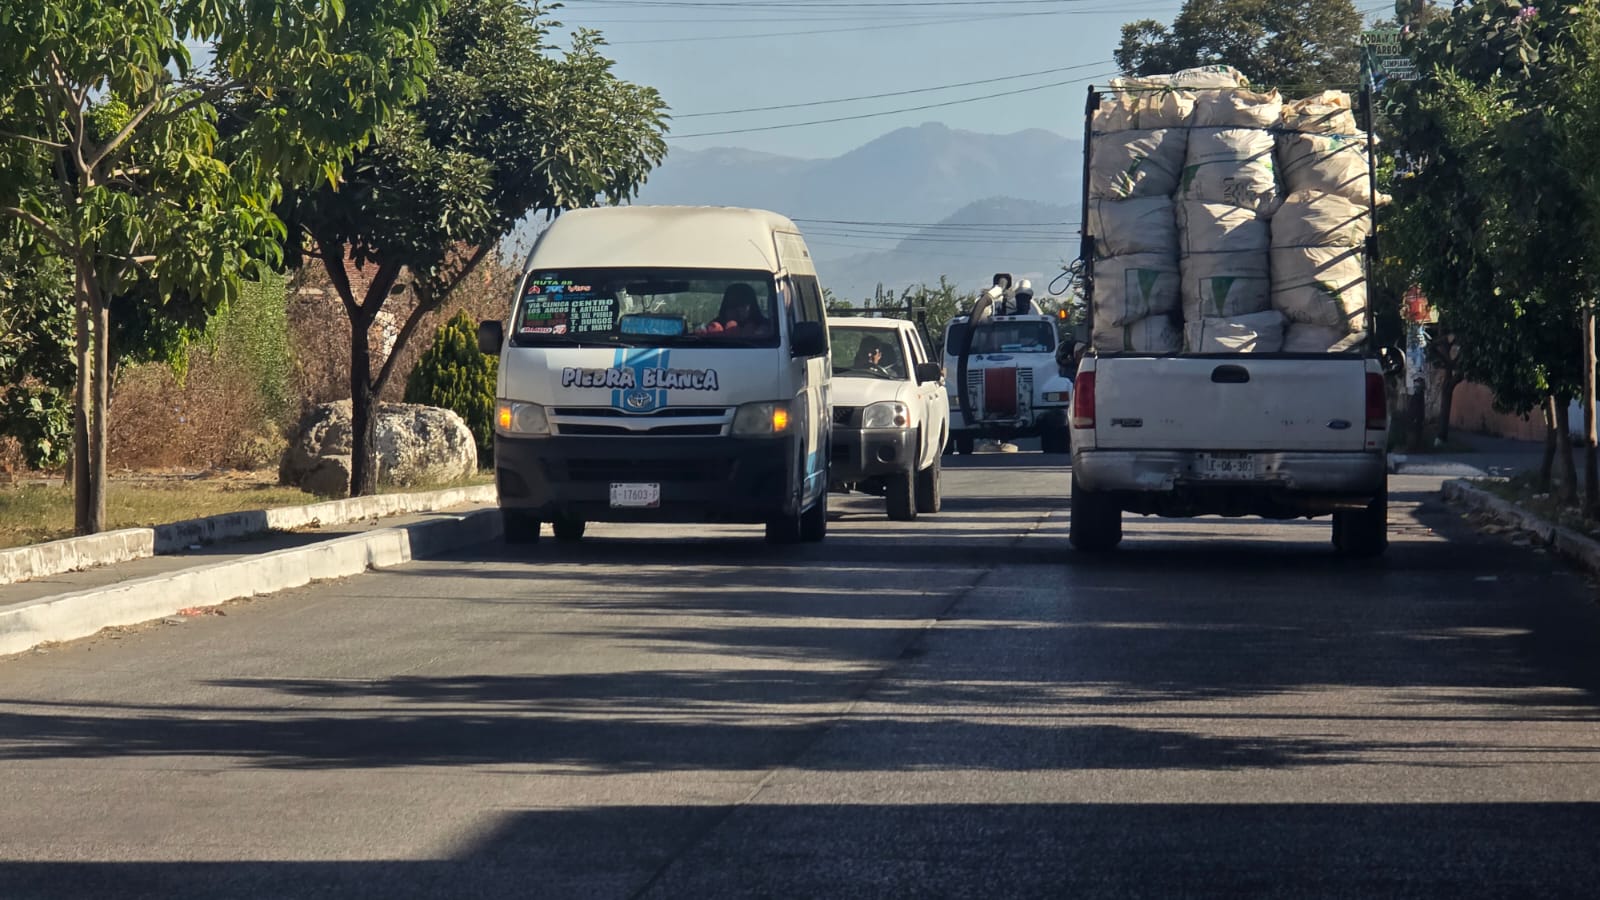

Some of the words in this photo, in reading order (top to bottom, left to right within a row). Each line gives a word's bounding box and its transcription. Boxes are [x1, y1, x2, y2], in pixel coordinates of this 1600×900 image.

[1376, 45, 1402, 55] ARBOL
[571, 299, 614, 307] CENTRO
[562, 367, 635, 388] PIEDRA
[642, 368, 719, 391] BLANCA
